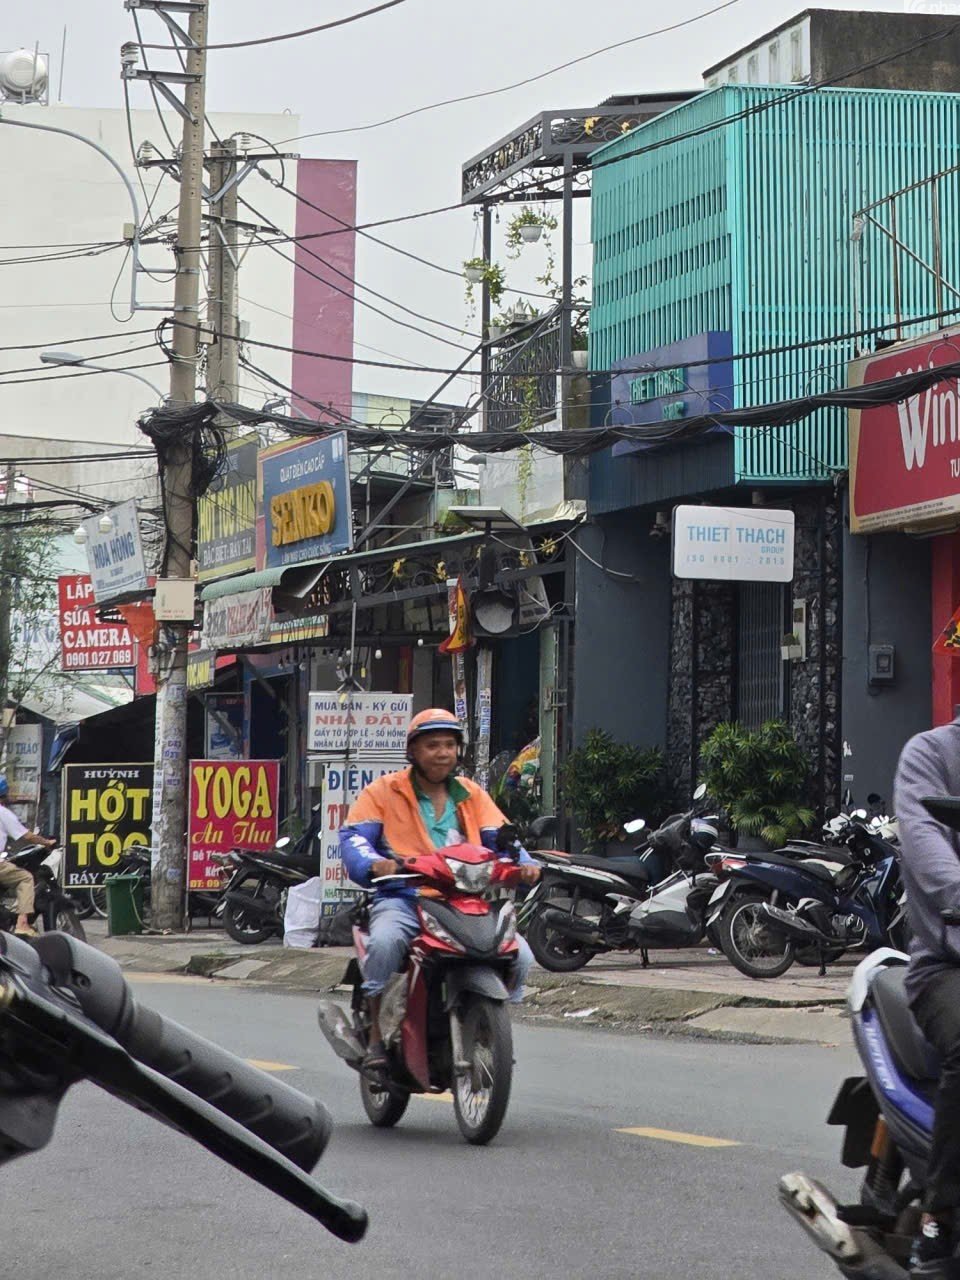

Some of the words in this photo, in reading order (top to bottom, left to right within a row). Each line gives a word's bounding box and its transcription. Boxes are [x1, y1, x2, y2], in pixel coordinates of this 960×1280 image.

[270, 481, 335, 548] SENKO
[687, 525, 730, 543] THIET
[735, 527, 786, 544] THACH
[761, 546, 785, 554] GROUP
[66, 577, 94, 600] LẮP
[63, 628, 132, 649] CAMERA
[65, 649, 132, 667] 0901.027.069
[314, 702, 338, 711] MUA
[364, 713, 406, 726] ĐẤT
[83, 769, 140, 780] HUỲNH
[70, 779, 150, 822] HỚT
[193, 766, 273, 819] YOGA
[191, 821, 223, 845] An
[232, 821, 272, 845] Thu
[69, 870, 100, 885] RÁY
